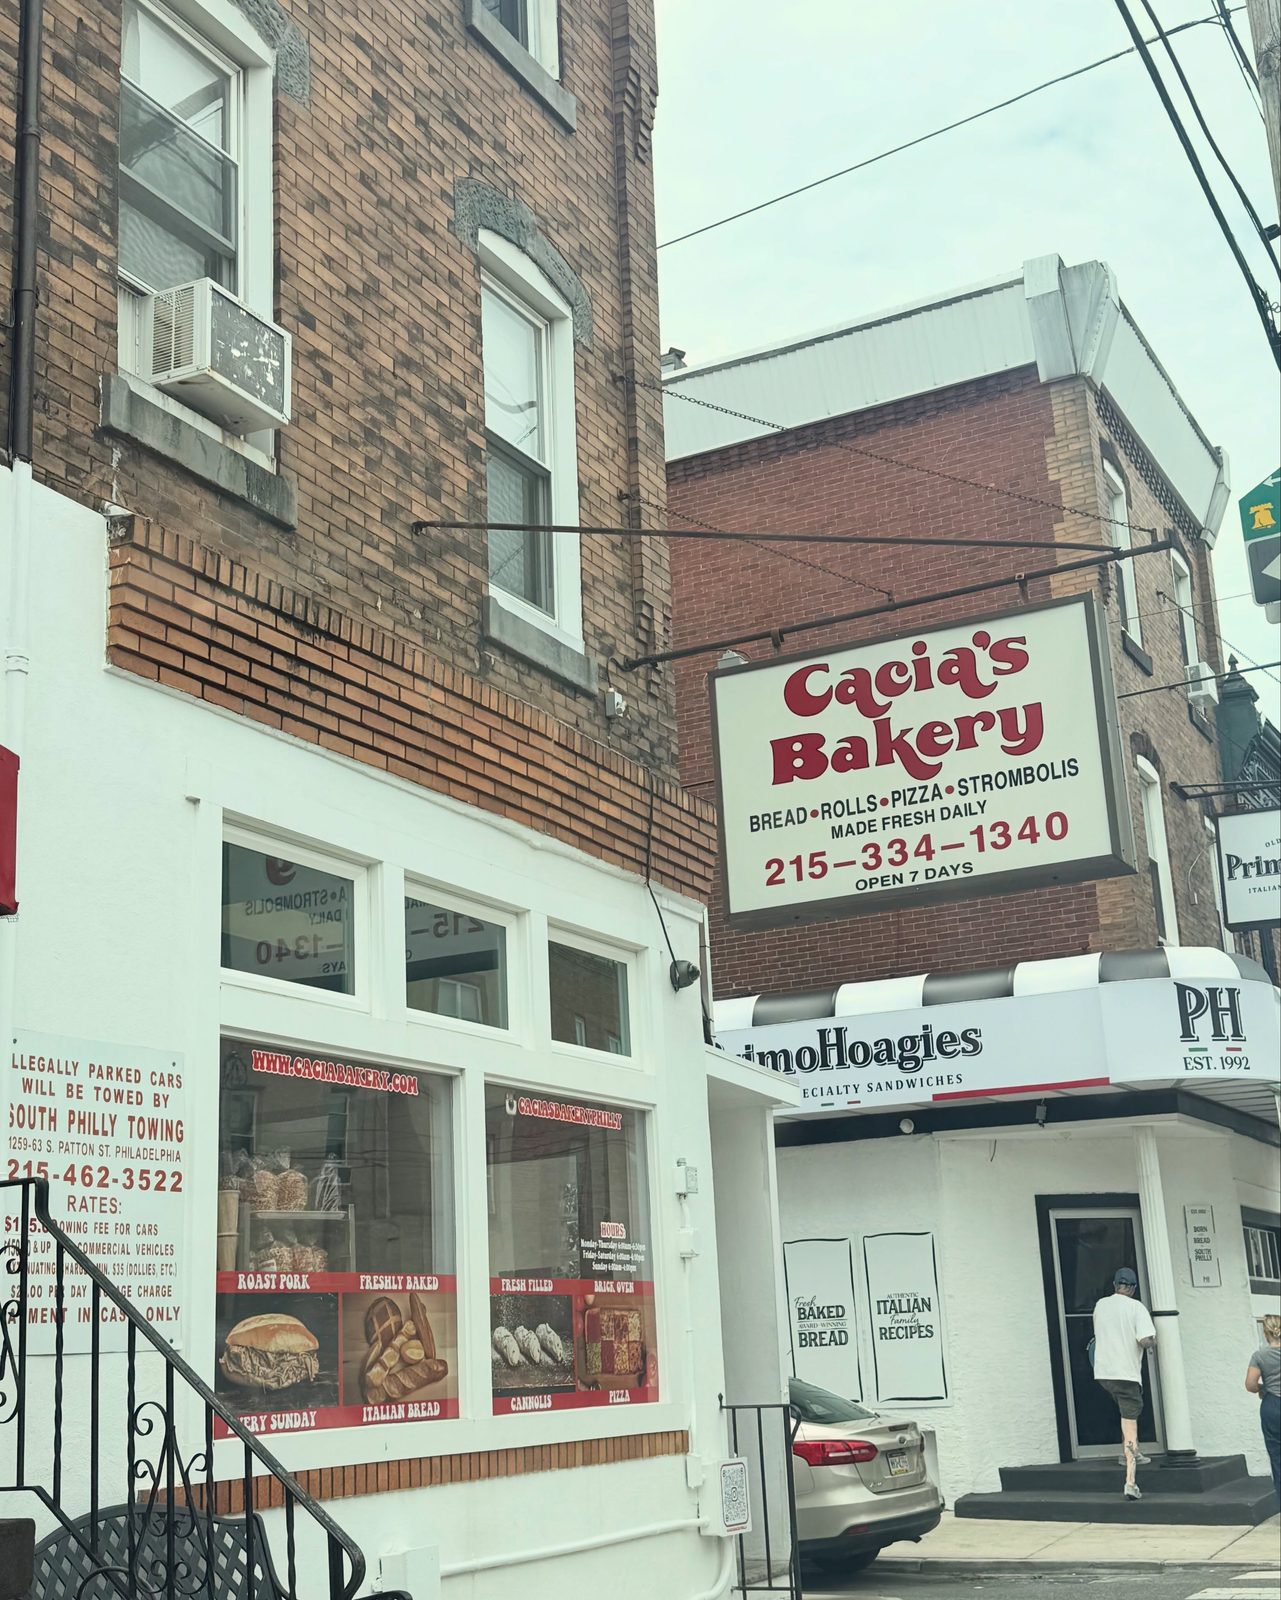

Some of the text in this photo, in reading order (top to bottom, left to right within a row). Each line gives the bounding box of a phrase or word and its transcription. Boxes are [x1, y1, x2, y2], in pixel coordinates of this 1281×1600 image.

[784, 630, 1029, 718] Cacia's
[770, 702, 1044, 785] Bakery
[749, 757, 1080, 832] BREAD ROLLS PIZZA STROMBOLIS
[830, 800, 988, 840] MADE FRESH DAILY
[765, 810, 1069, 886] 215-334-1340
[855, 862, 974, 891] OPEN 7 DAYS
[1173, 982, 1246, 1042] PH
[715, 1024, 983, 1075] imoHoagies
[12, 1053, 182, 1089] LLEGALLY PARKED CARS
[1183, 1056, 1250, 1070] EST. 1992
[252, 1050, 418, 1096] WWW.CACIABAKERY.COM
[22, 1077, 170, 1108] WILL BE TOWED BY
[802, 1074, 964, 1099] ECIALTY SANDWICHES
[9, 1102, 184, 1143] SOUTH PHILLY TOWING
[8, 1136, 182, 1162] 1259-63 S. PATTON ST. PHILADELPHIA
[7, 1158, 183, 1192] 215-462-3522
[67, 1195, 122, 1214] RATES:
[60, 1220, 88, 1234] OWING
[94, 1222, 109, 1235] FEE
[114, 1223, 130, 1236] FOR
[136, 1224, 158, 1236] CARS
[40, 1241, 51, 1254] UP
[77, 1242, 130, 1256] COMMERCIAL
[136, 1244, 174, 1256] VEHICLES
[112, 1264, 124, 1276] $35
[238, 1274, 310, 1290] ROAST PORK
[360, 1275, 439, 1291] FRESHLY BAKED
[502, 1279, 553, 1292] FRESH FILLED
[594, 1281, 634, 1294] BRICK OVEN
[71, 1285, 88, 1298] DAY
[138, 1285, 172, 1298] CHARGE
[794, 1295, 816, 1308] Fresh
[876, 1297, 932, 1314] ITALIAN
[78, 1307, 90, 1323] IN
[100, 1307, 126, 1322] CAS
[146, 1306, 180, 1322] ONLY
[797, 1305, 846, 1320] BAKED
[890, 1312, 920, 1328] Family
[798, 1330, 848, 1348] BREAD
[878, 1324, 934, 1340] RECIPES
[510, 1395, 552, 1411] CANNOLIS
[609, 1390, 630, 1404] PIZZA
[270, 1411, 318, 1430] SUNDAY
[362, 1402, 440, 1422] ITALIAN BREAD
